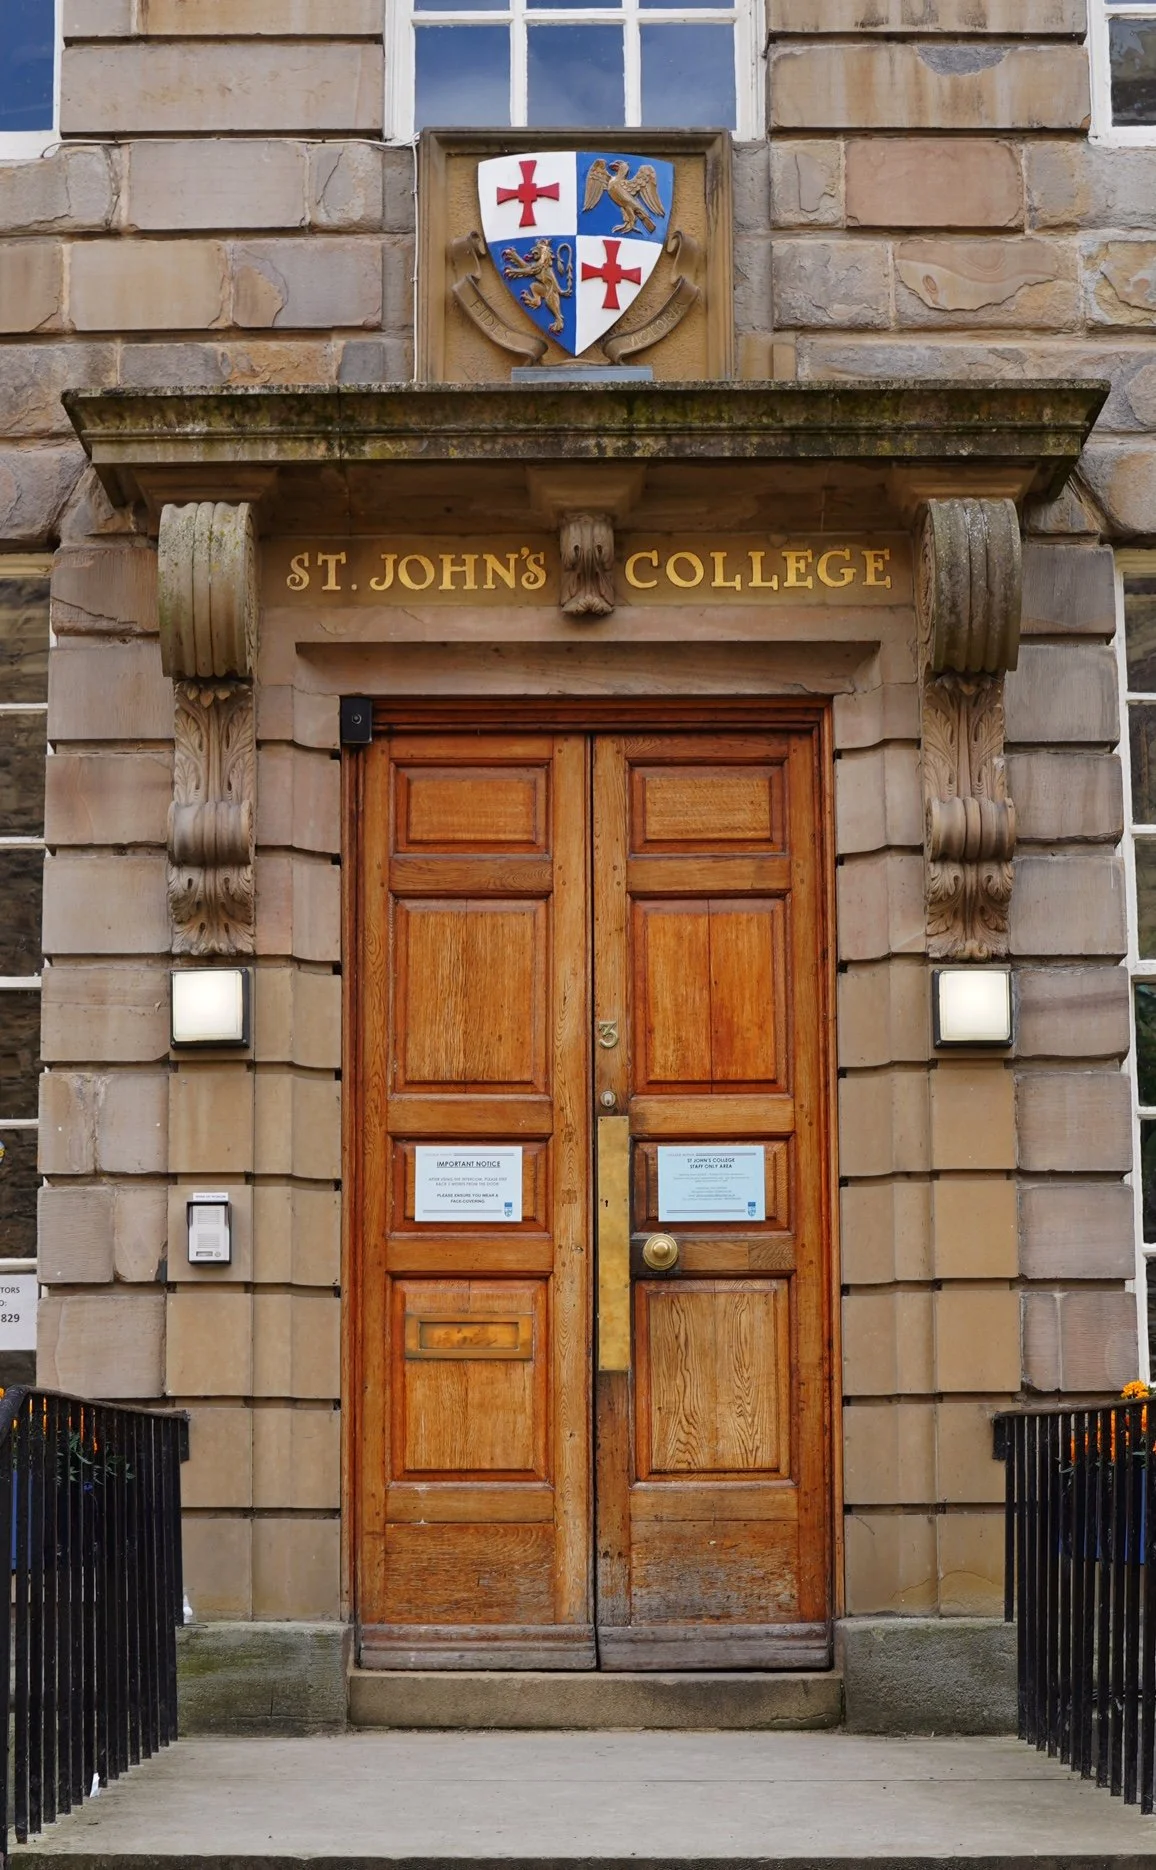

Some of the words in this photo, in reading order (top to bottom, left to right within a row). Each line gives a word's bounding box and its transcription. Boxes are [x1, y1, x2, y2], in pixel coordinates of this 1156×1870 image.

[470, 299, 512, 338] FIDES
[286, 552, 358, 591] ST.
[369, 546, 547, 591] JOHN'S
[624, 548, 892, 591] COLLEGE
[598, 1021, 619, 1048] 3
[1, 1313, 20, 1323] 829
